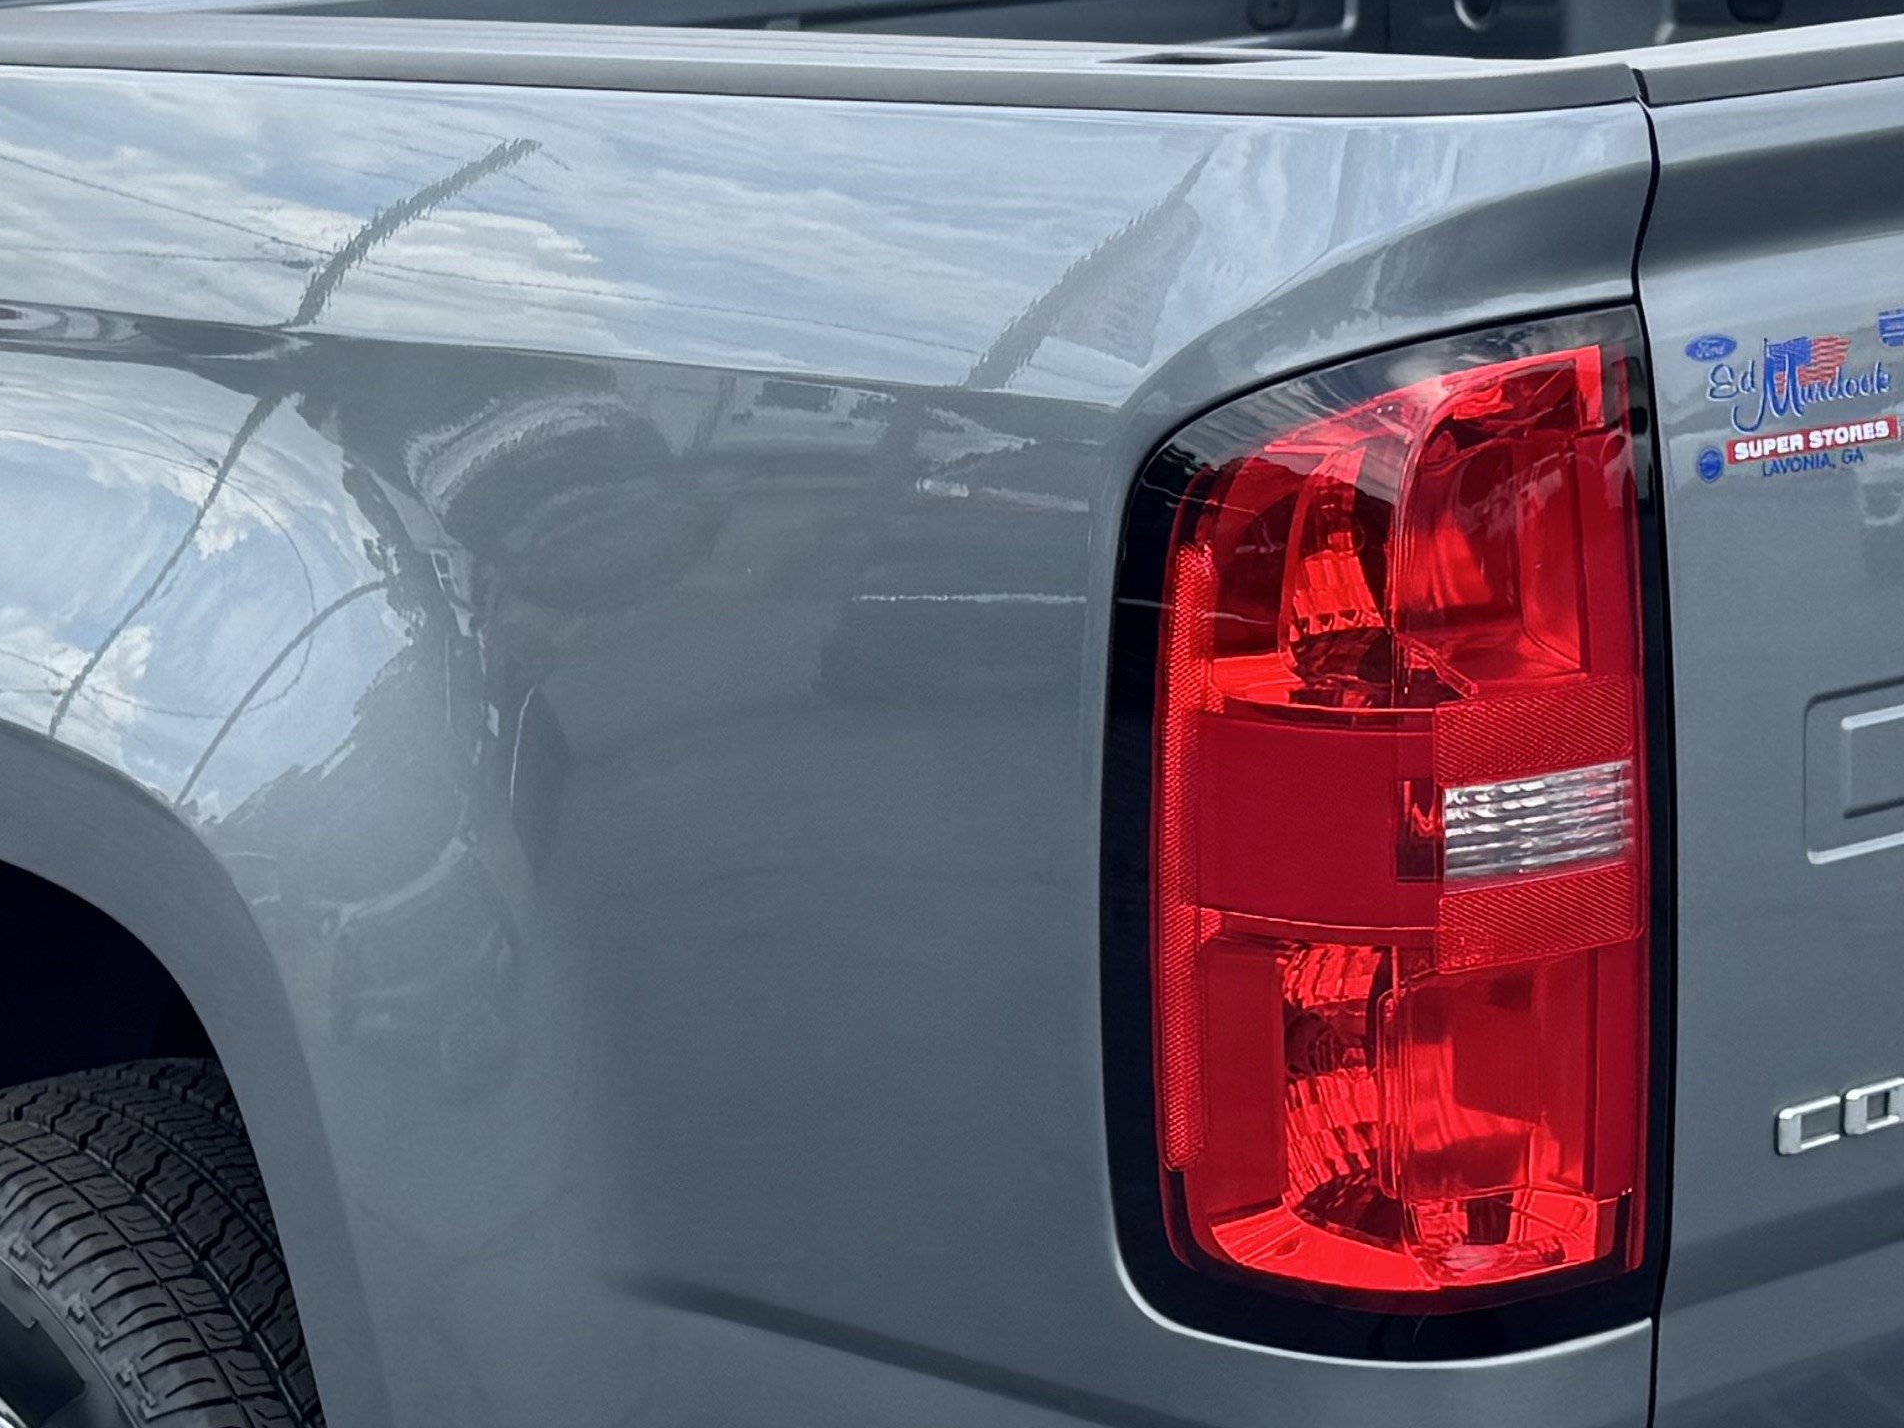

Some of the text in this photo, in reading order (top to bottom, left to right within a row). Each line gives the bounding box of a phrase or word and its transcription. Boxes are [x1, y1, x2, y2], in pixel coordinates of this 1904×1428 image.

[1706, 359, 1758, 402] Ed
[1733, 420, 1890, 461] SUPER STORES
[1761, 447, 1864, 478] LAVONIA, GA
